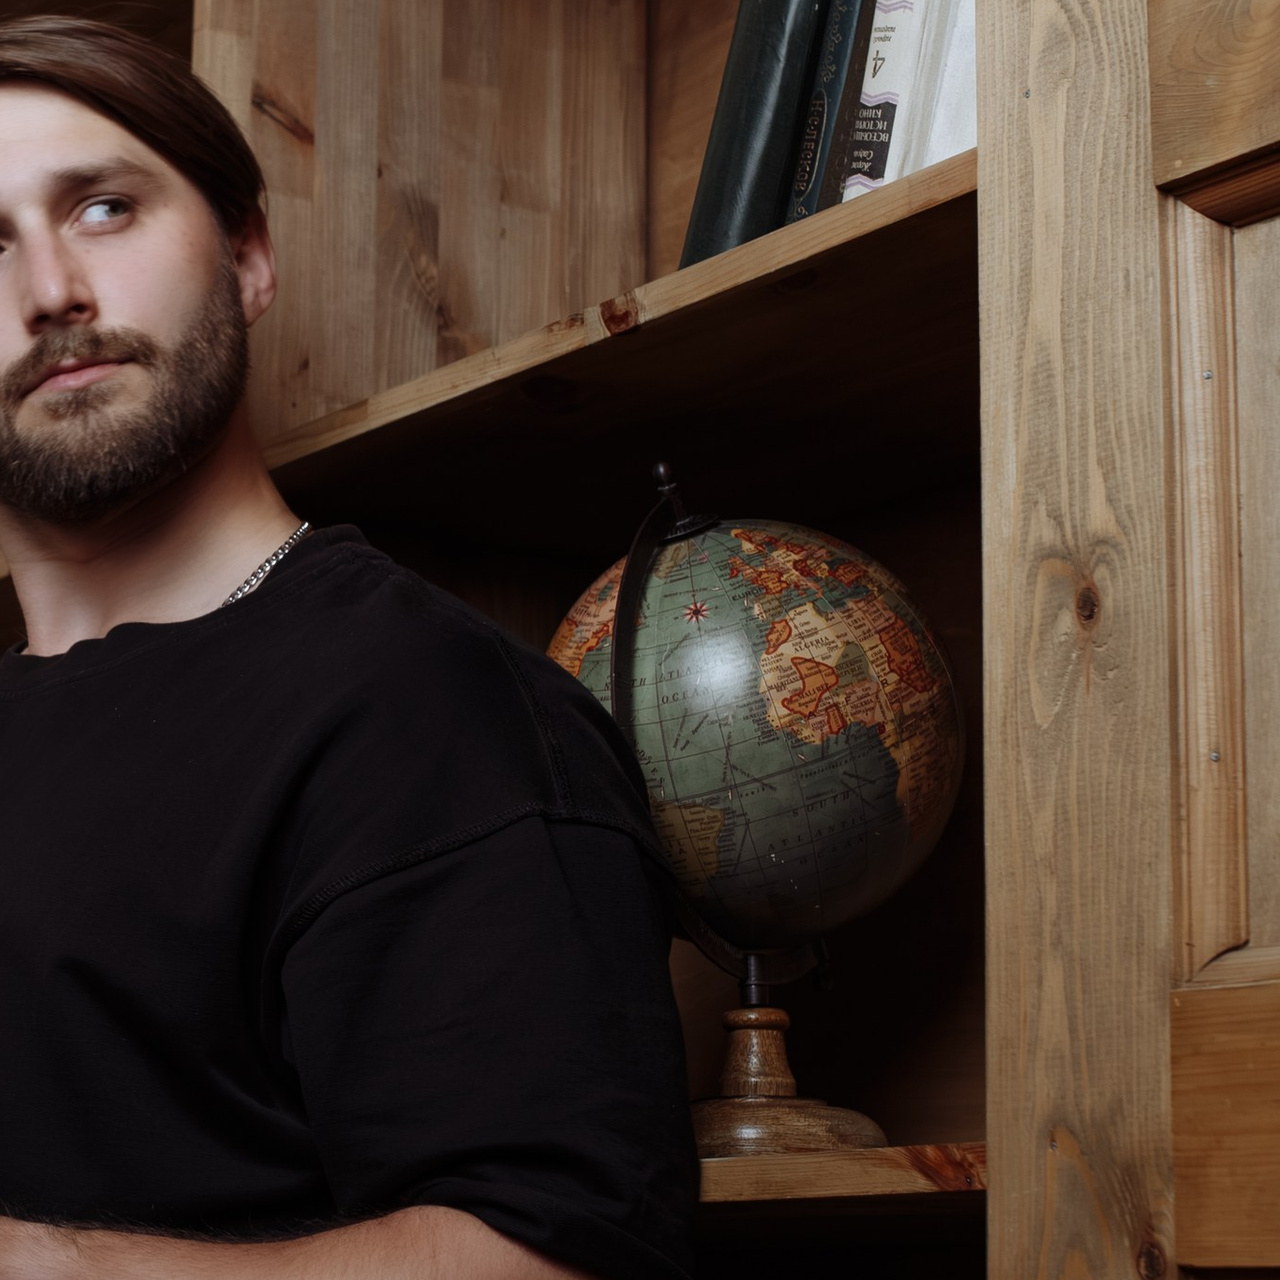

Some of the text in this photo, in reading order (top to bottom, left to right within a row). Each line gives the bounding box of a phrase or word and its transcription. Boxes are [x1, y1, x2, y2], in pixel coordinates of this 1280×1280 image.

[872, 50, 886, 79] 4
[794, 635, 830, 654] ALGERIA
[791, 790, 851, 815] SOUTH
